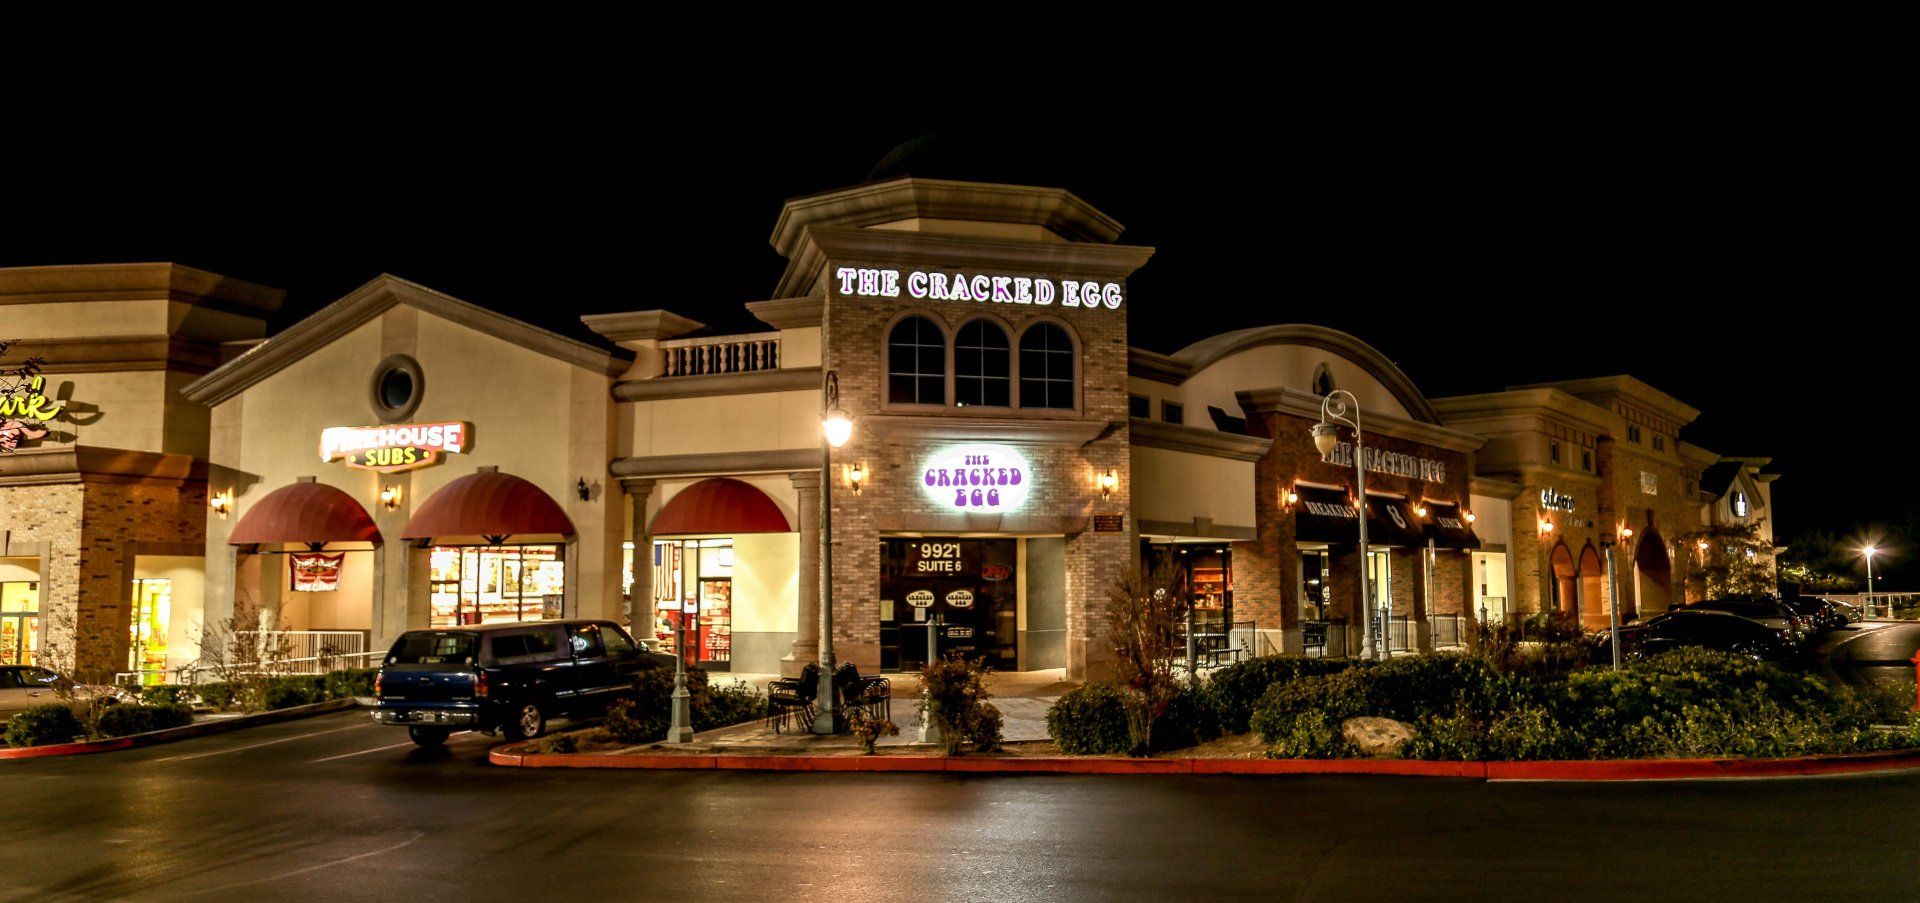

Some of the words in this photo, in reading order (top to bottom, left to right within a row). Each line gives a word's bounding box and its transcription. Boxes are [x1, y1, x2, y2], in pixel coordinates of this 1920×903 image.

[837, 268, 900, 297] THE
[907, 271, 1055, 305] CRACKED
[1061, 280, 1122, 309] EGG
[365, 446, 416, 466] SUBS
[965, 455, 990, 466] THE
[1321, 441, 1352, 468] HE
[1420, 459, 1446, 483] EGG
[925, 468, 1022, 486] CRACKED
[954, 488, 1000, 507] EGG
[921, 543, 960, 558] 9921
[917, 560, 954, 572] SUITE
[955, 560, 962, 572] 6
